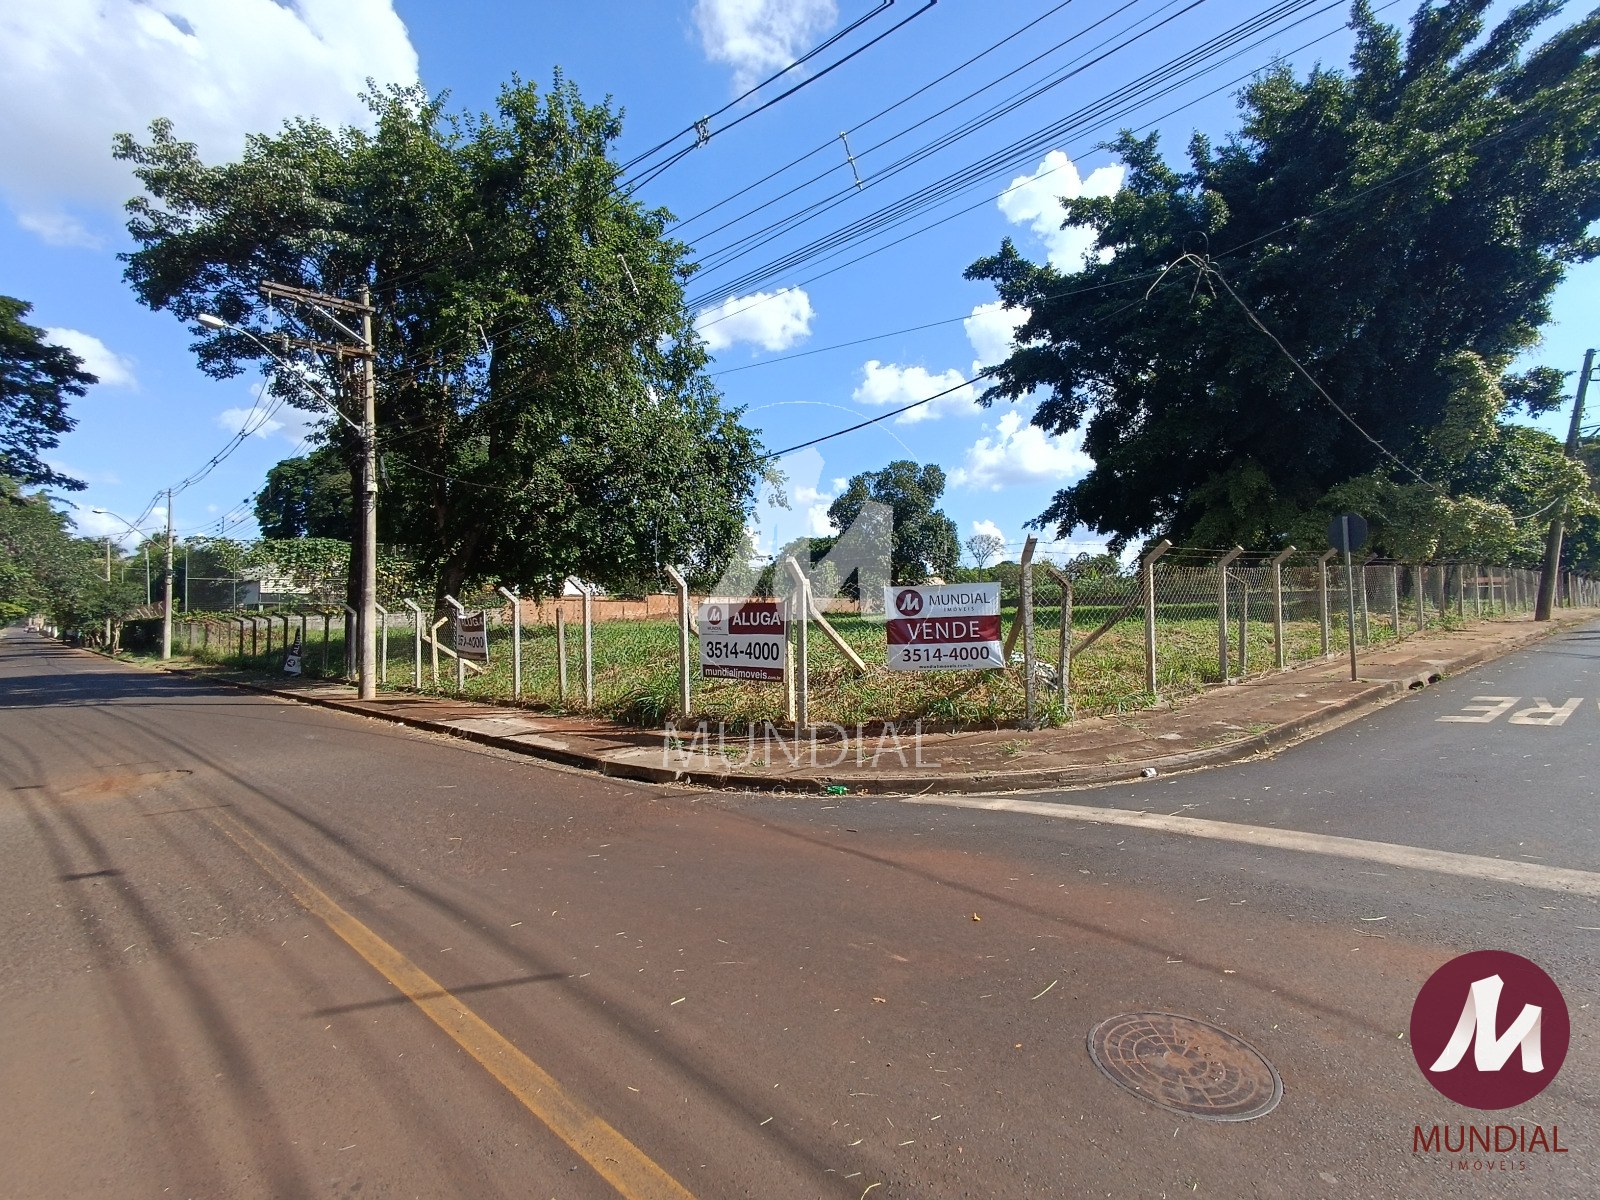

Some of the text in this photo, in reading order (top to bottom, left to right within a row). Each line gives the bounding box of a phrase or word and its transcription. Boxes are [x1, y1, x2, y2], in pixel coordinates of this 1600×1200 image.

[929, 592, 990, 606] MUNDIAL
[461, 616, 484, 627] LUGA
[732, 611, 780, 626] ALUGA
[907, 620, 980, 640] VENDE
[706, 641, 779, 661] 3514-4000
[902, 646, 990, 662] 3514-4000
[1434, 695, 1600, 727] RE
